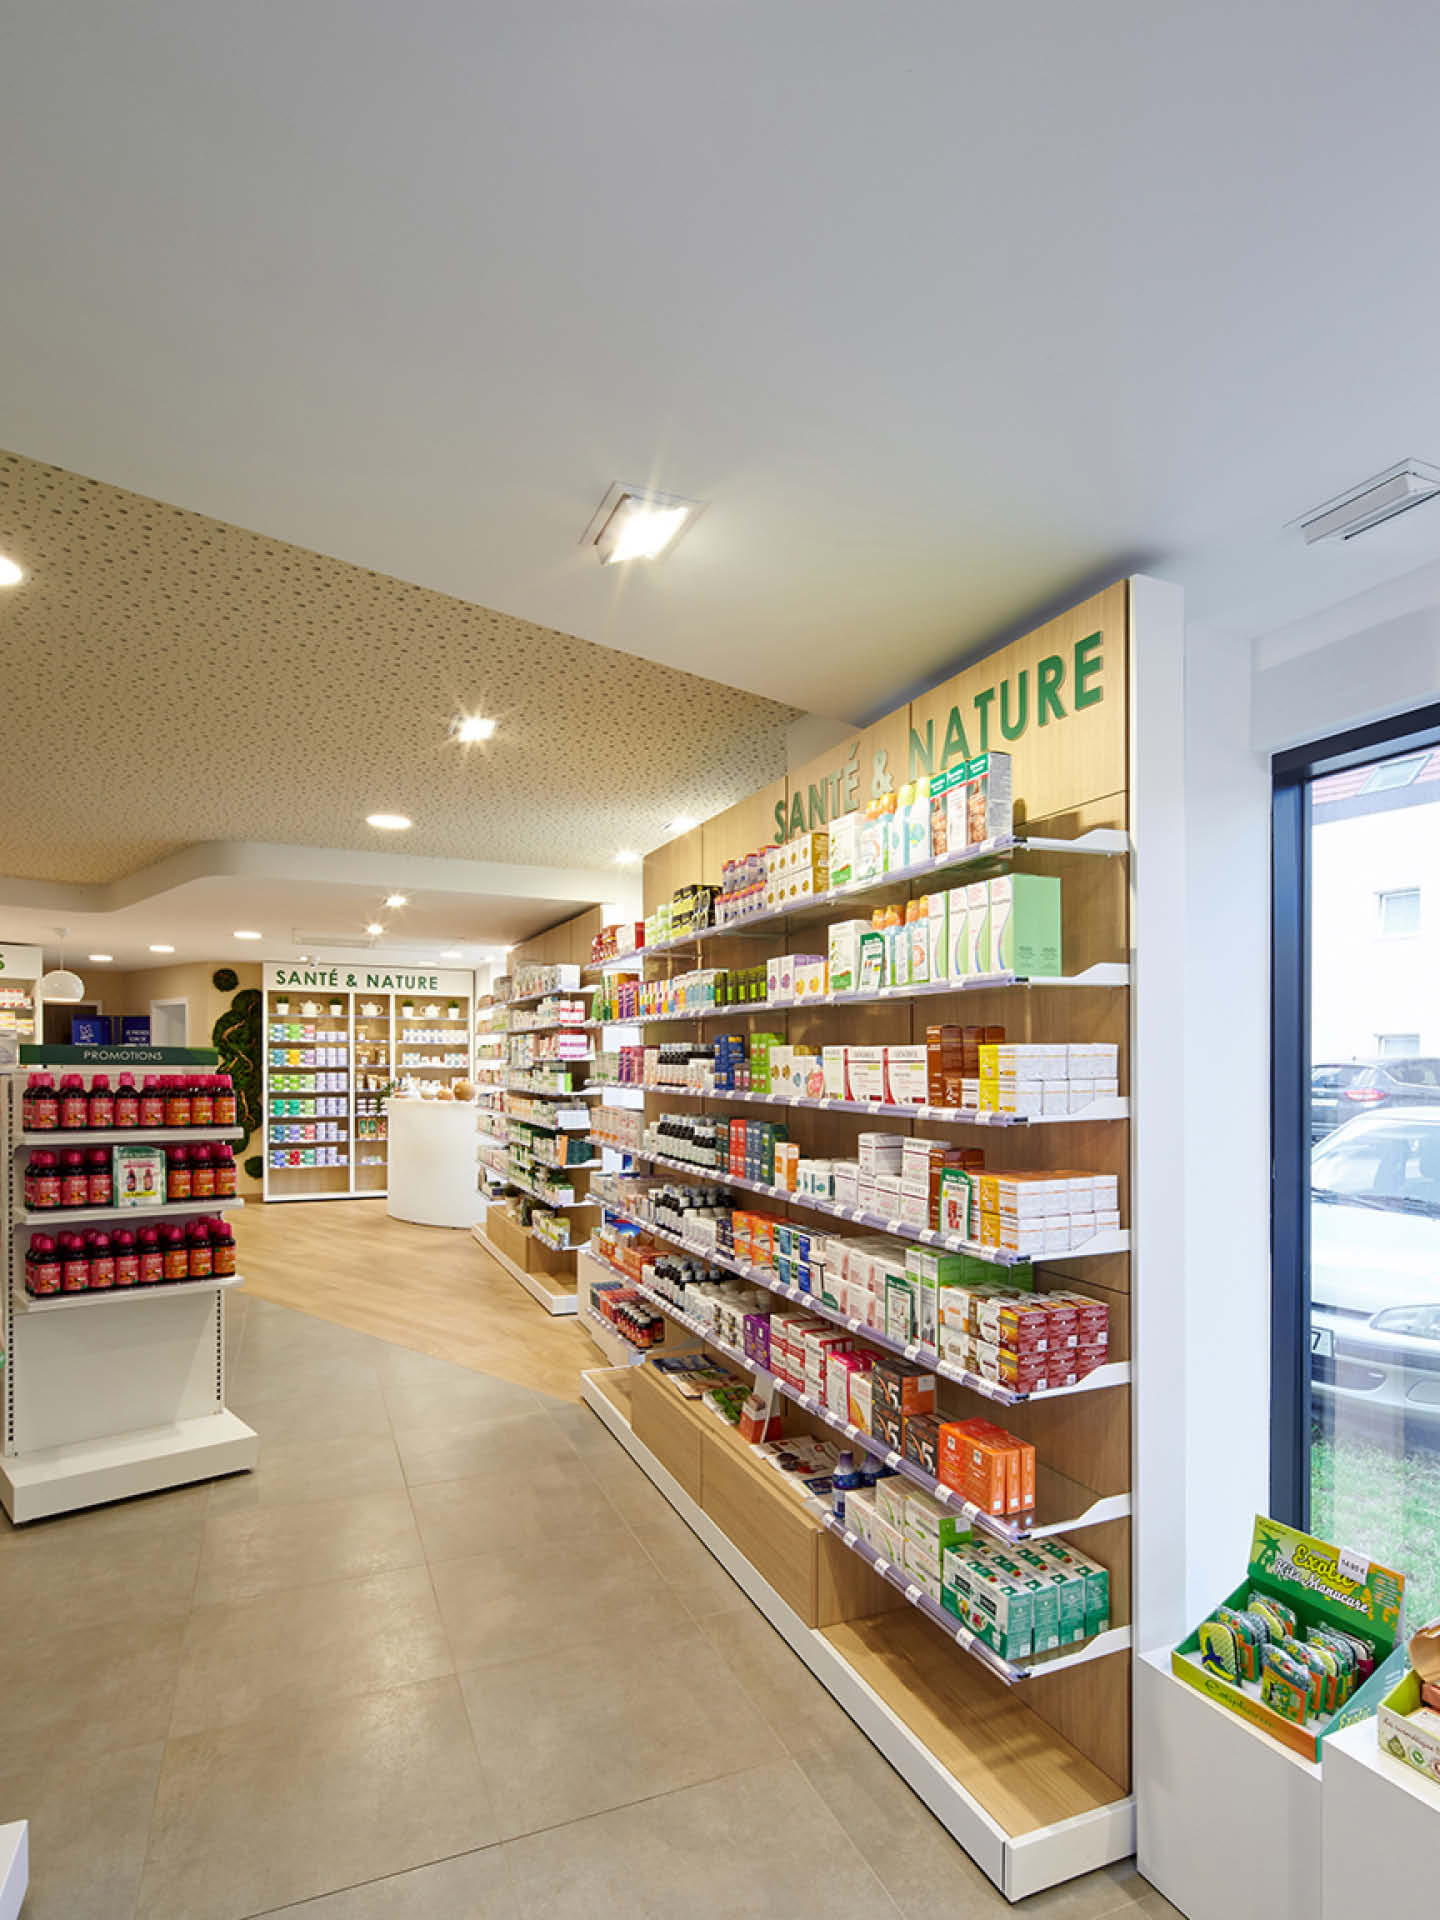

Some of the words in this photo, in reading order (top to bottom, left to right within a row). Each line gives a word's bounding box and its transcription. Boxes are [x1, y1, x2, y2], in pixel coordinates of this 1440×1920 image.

[774, 741, 861, 844] SANTÉ
[872, 747, 895, 799] &
[909, 631, 1103, 781] NATURE
[276, 968, 338, 986] SANTÉ
[346, 974, 358, 987] &
[367, 974, 439, 990] NATURE
[83, 1050, 163, 1060] PROMOTIONS
